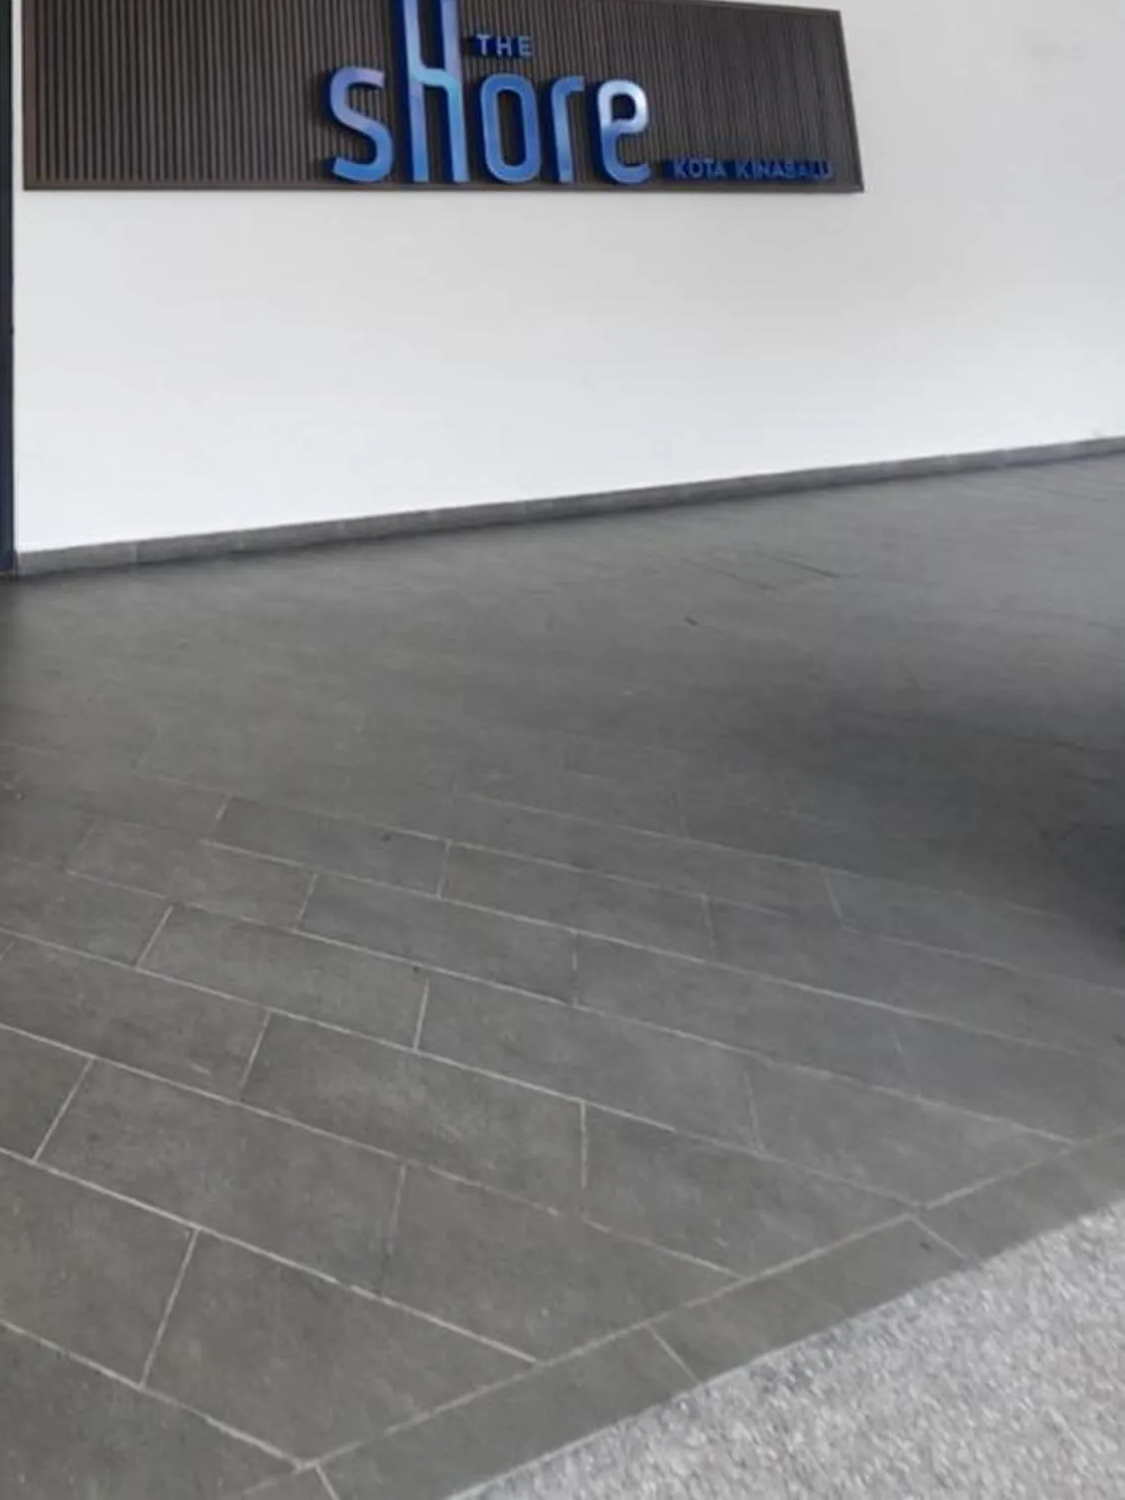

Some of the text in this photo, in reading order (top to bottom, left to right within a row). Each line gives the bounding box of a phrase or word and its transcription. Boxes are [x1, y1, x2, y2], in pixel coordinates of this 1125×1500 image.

[474, 33, 533, 57] THE
[674, 158, 833, 182] KOTA KINABALU
